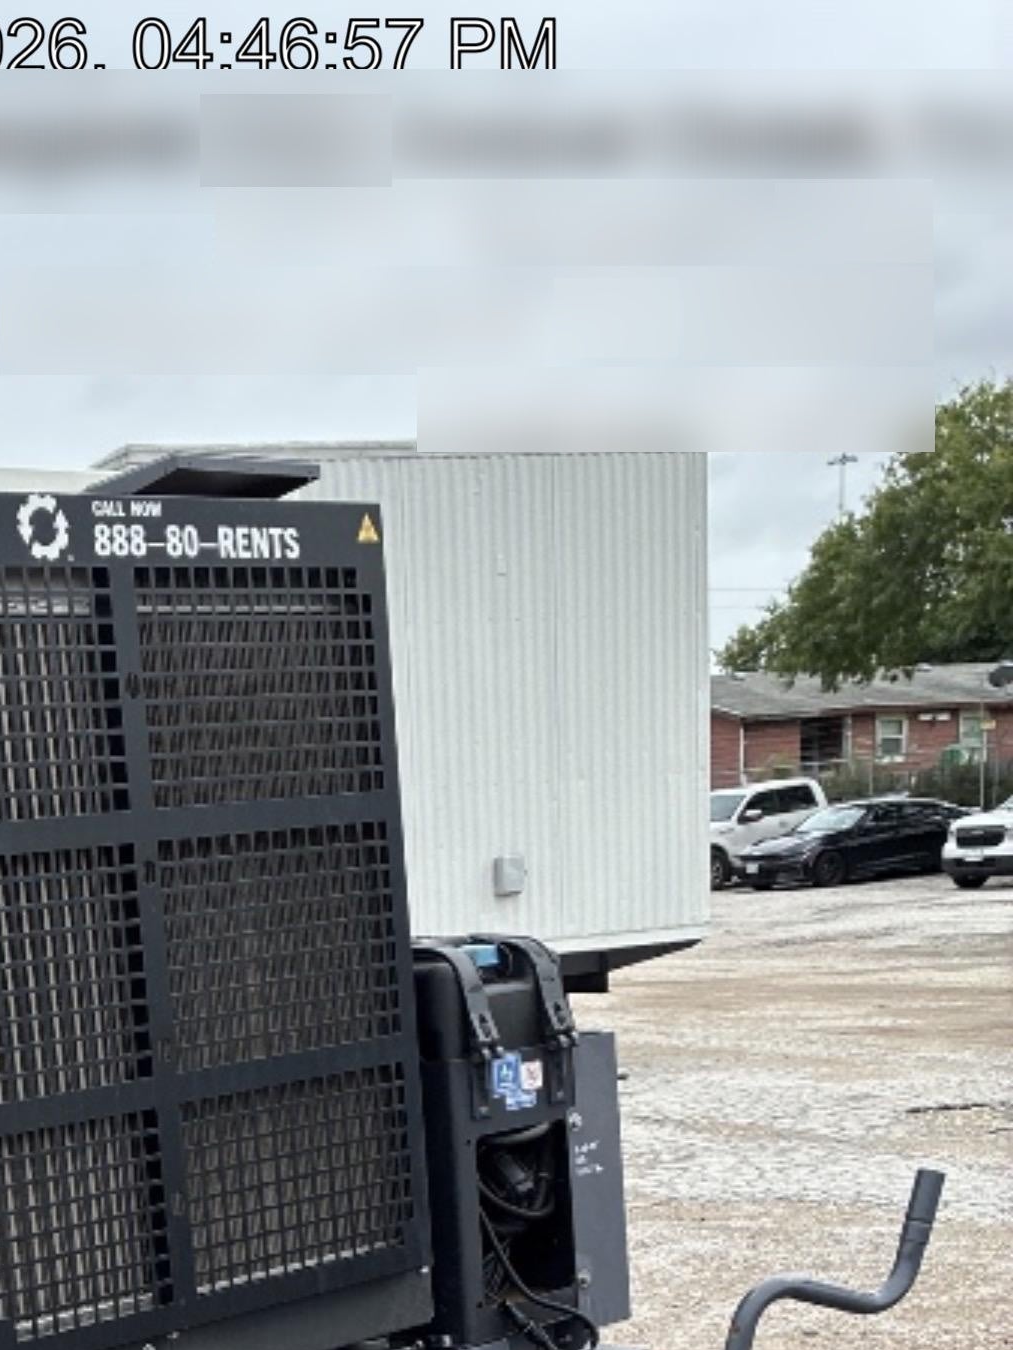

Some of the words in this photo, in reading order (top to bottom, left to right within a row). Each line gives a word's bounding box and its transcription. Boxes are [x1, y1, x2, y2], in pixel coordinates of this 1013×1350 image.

[92, 501, 126, 517] CALL
[130, 501, 162, 517] NOW
[93, 524, 300, 559] 888-80-RENTS
